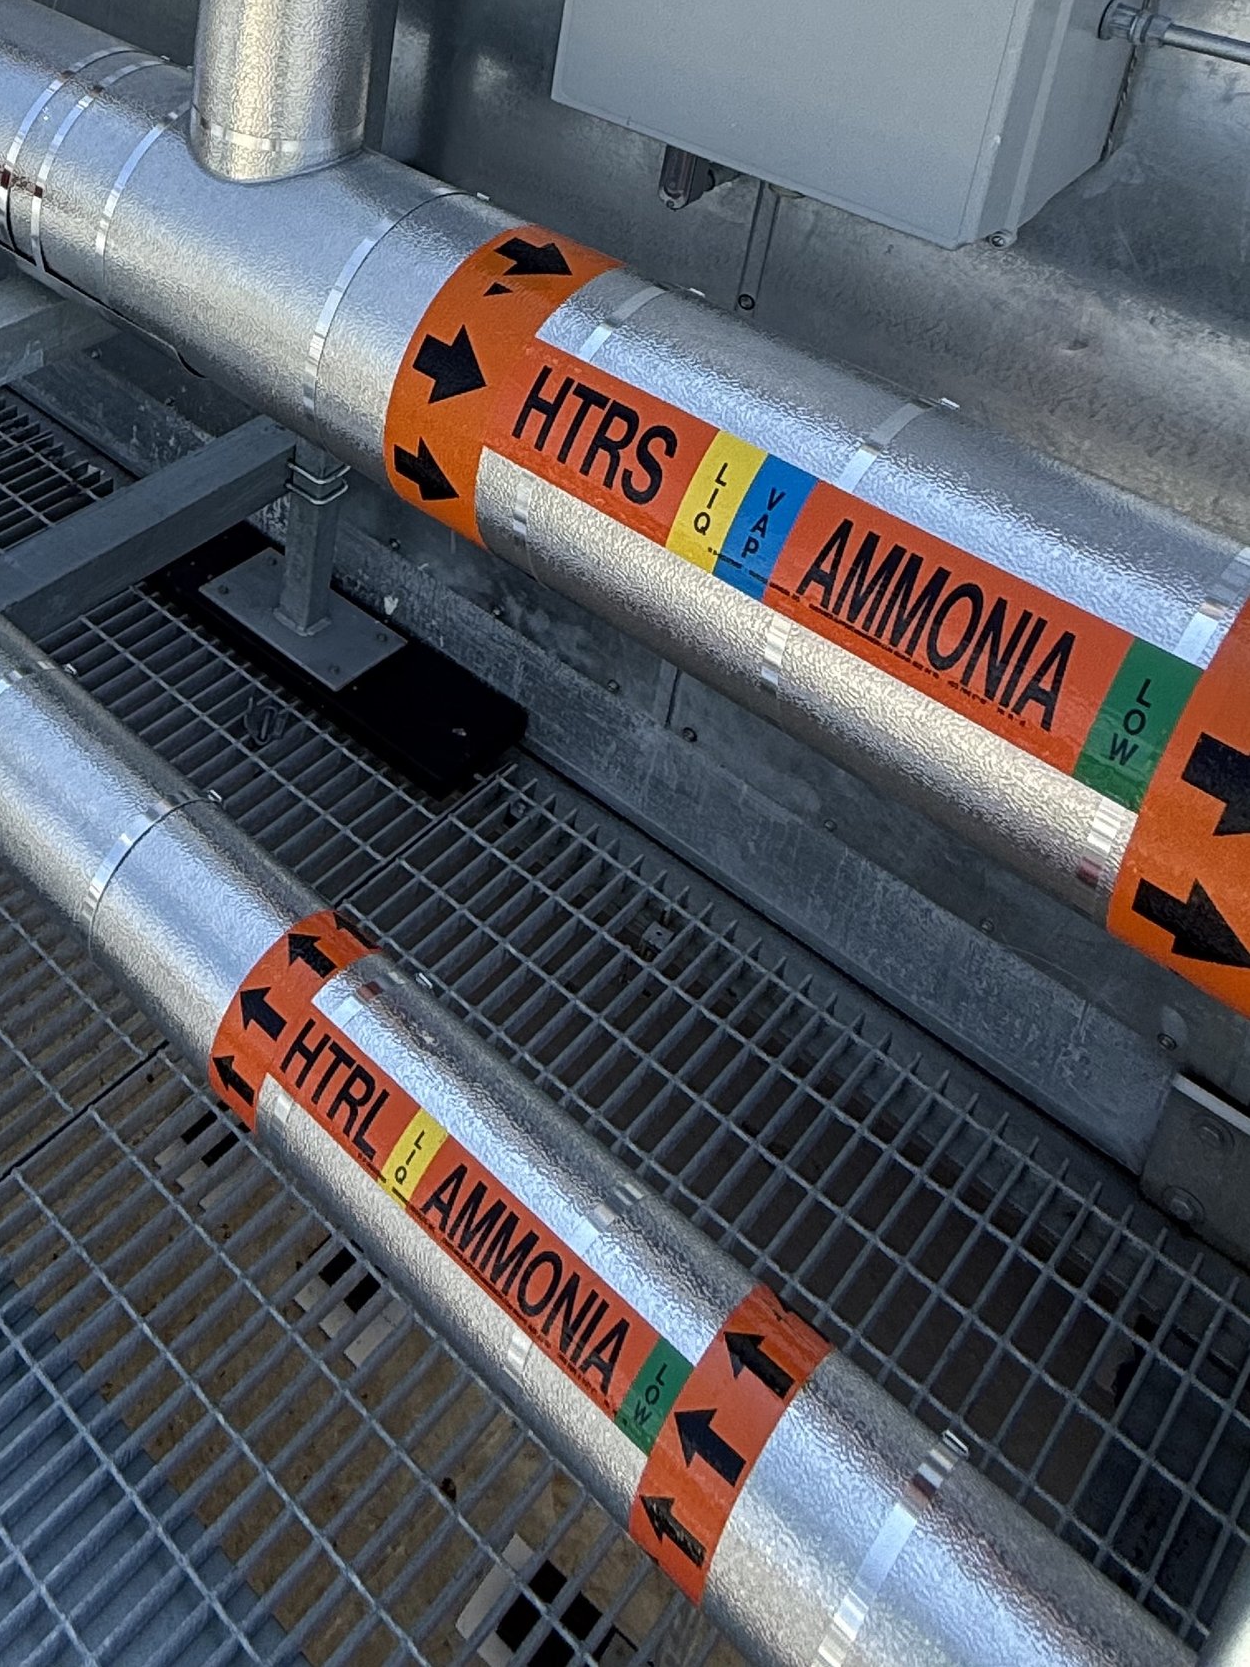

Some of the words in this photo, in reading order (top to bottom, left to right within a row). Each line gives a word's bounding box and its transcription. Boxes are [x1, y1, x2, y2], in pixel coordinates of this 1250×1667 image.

[511, 365, 678, 505] HTRS
[693, 462, 727, 537] LIQ
[740, 487, 786, 558] VAP
[796, 518, 1076, 733] AMMONIA
[1110, 678, 1152, 766] LOW
[280, 1018, 390, 1162] HTRL
[394, 1130, 425, 1185] LIQ
[419, 1162, 630, 1396] AMMONIA
[633, 1362, 668, 1426] LOW
